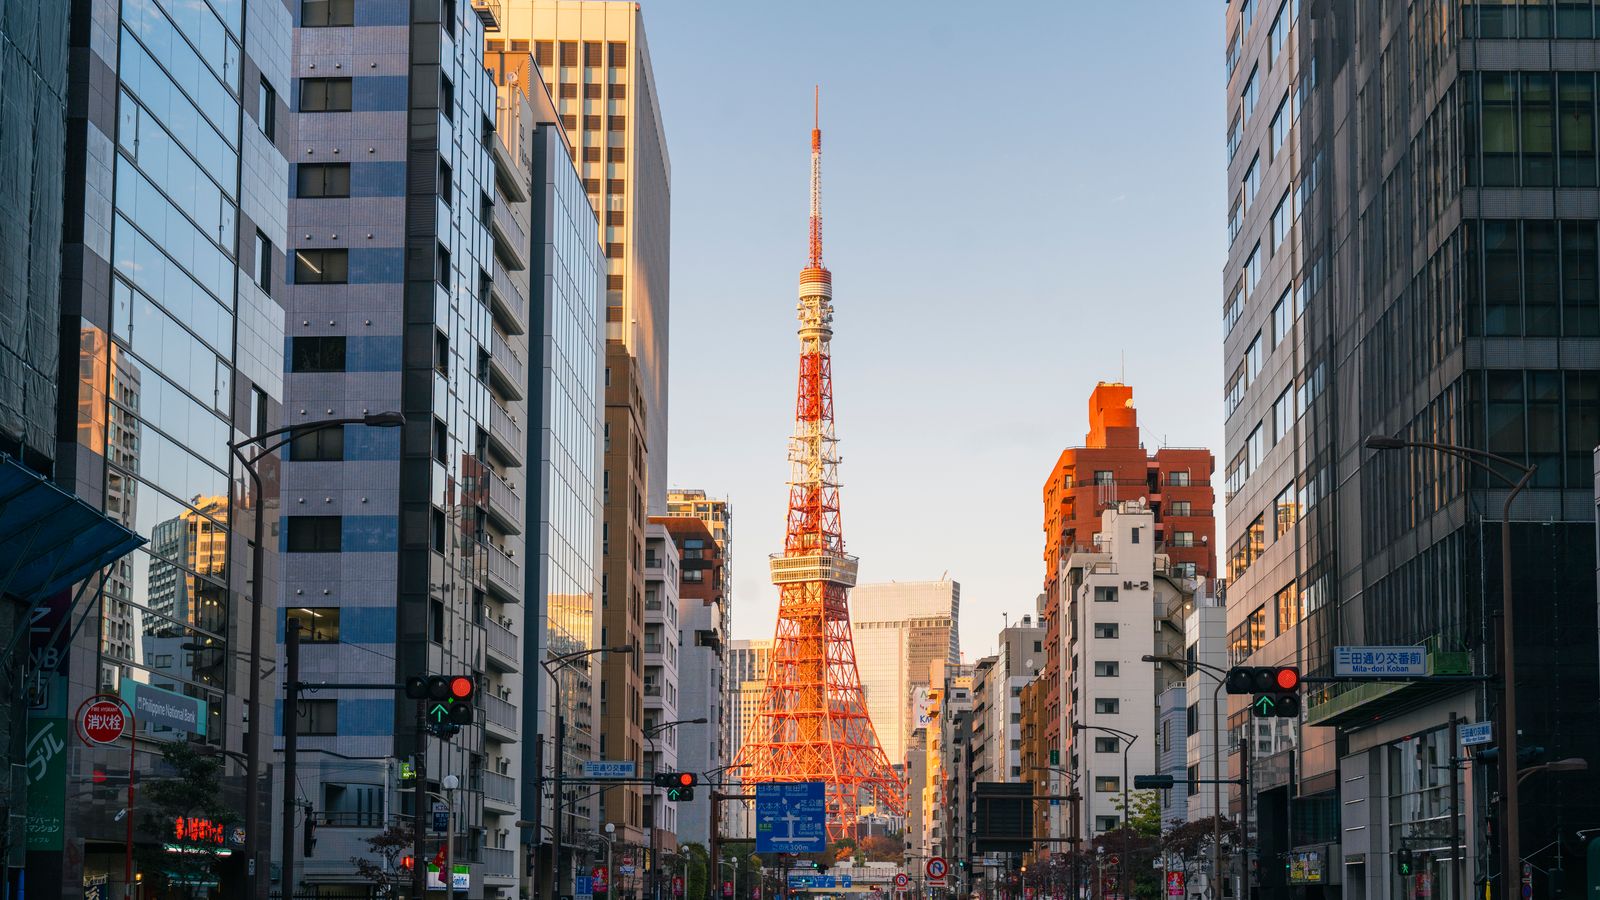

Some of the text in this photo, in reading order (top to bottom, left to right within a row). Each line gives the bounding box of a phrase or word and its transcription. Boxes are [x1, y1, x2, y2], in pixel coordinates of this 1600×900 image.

[1123, 580, 1149, 591] M-2
[1339, 652, 1421, 665] 三田通り交番前
[1352, 665, 1409, 673] Mita-dori Koban
[142, 697, 196, 723] Philippine National Bank
[88, 714, 121, 730] 消火栓
